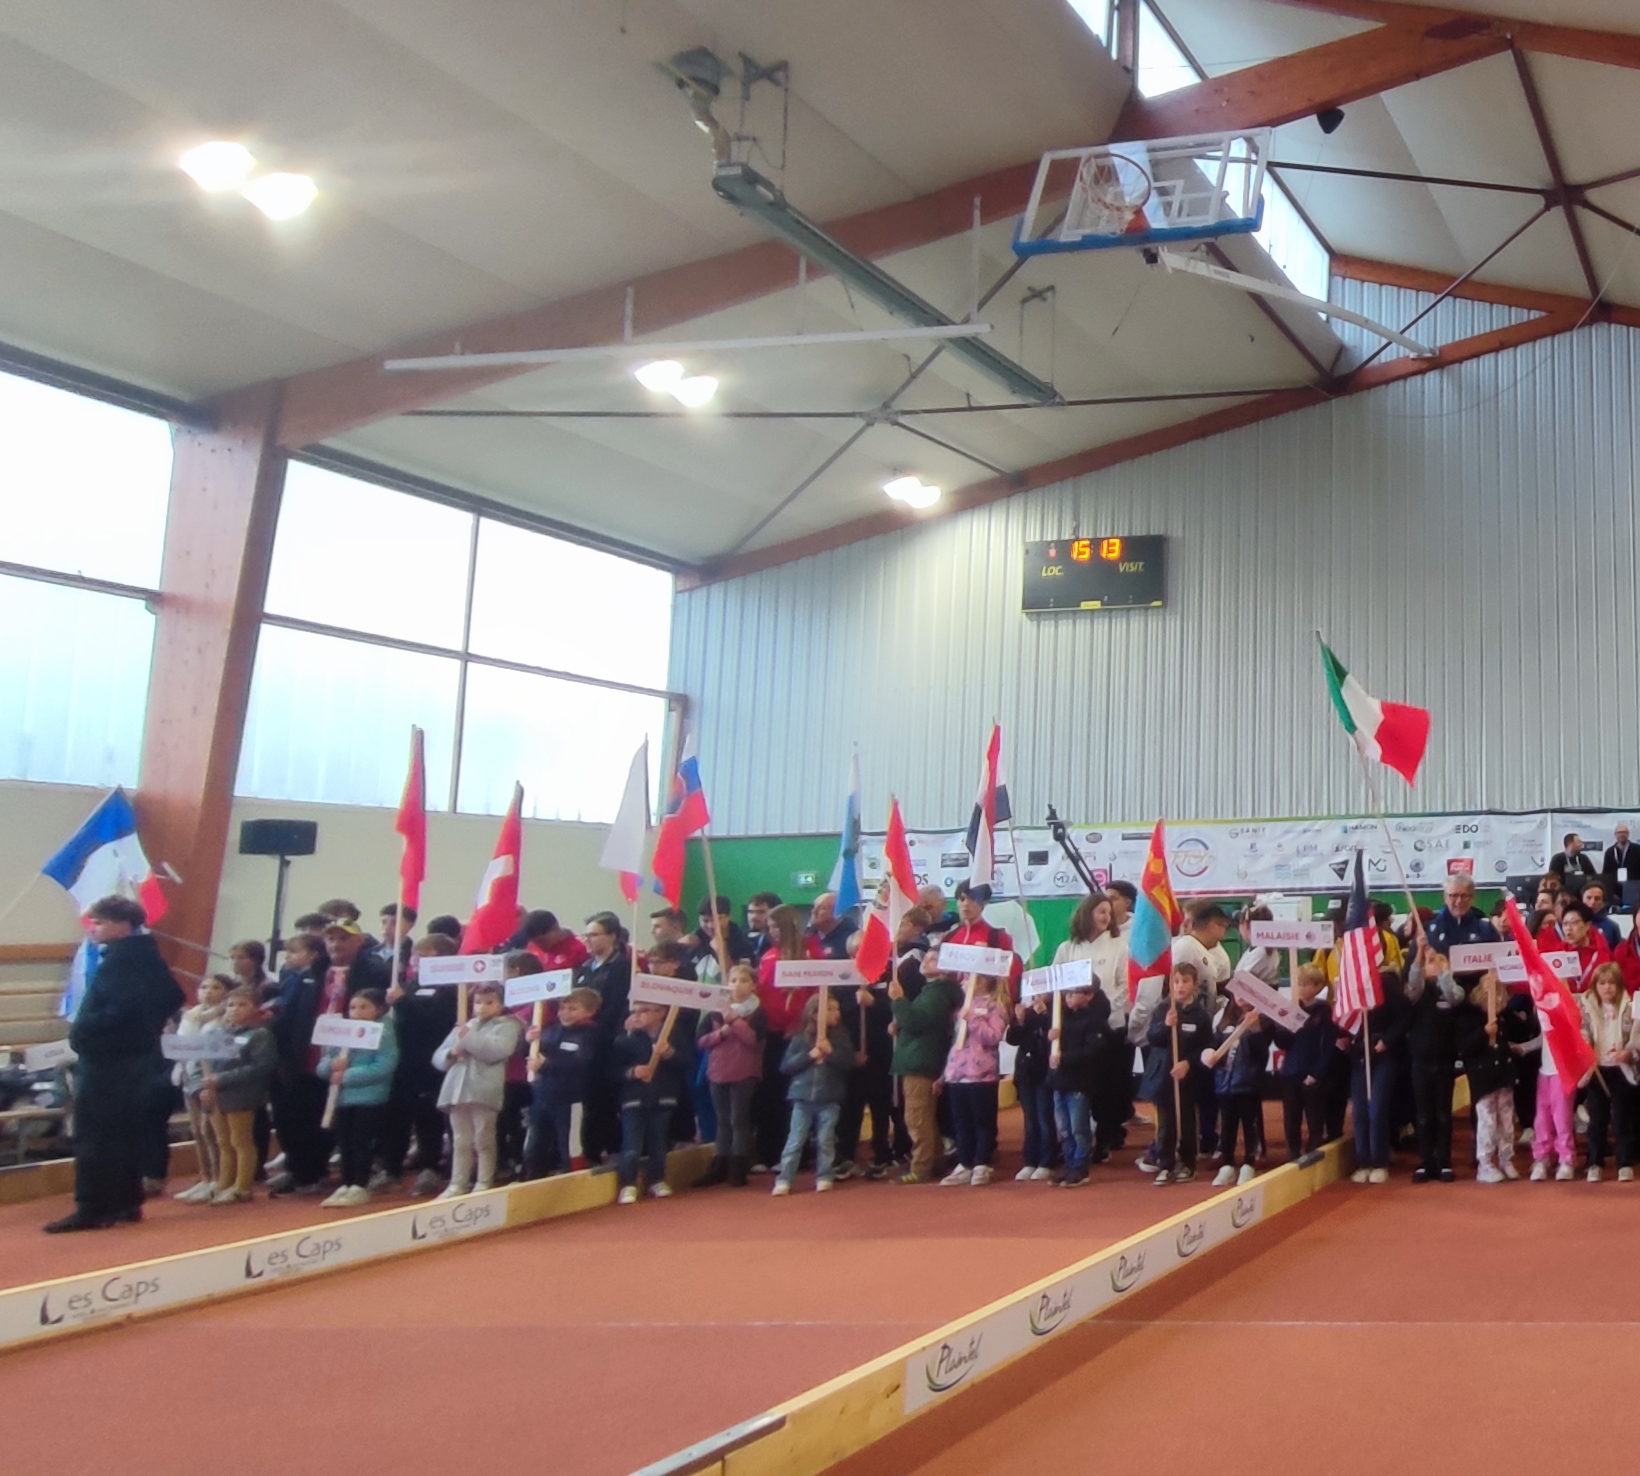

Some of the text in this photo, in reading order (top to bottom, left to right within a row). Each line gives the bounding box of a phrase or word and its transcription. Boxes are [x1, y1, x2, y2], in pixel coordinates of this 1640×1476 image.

[1071, 538, 1122, 560] 15 13
[1256, 931, 1300, 941] MALAISIE
[1463, 953, 1493, 965] ITALIE
[452, 1202, 491, 1226] Caps
[295, 1235, 342, 1260] Caps
[101, 1276, 160, 1303] Caps
